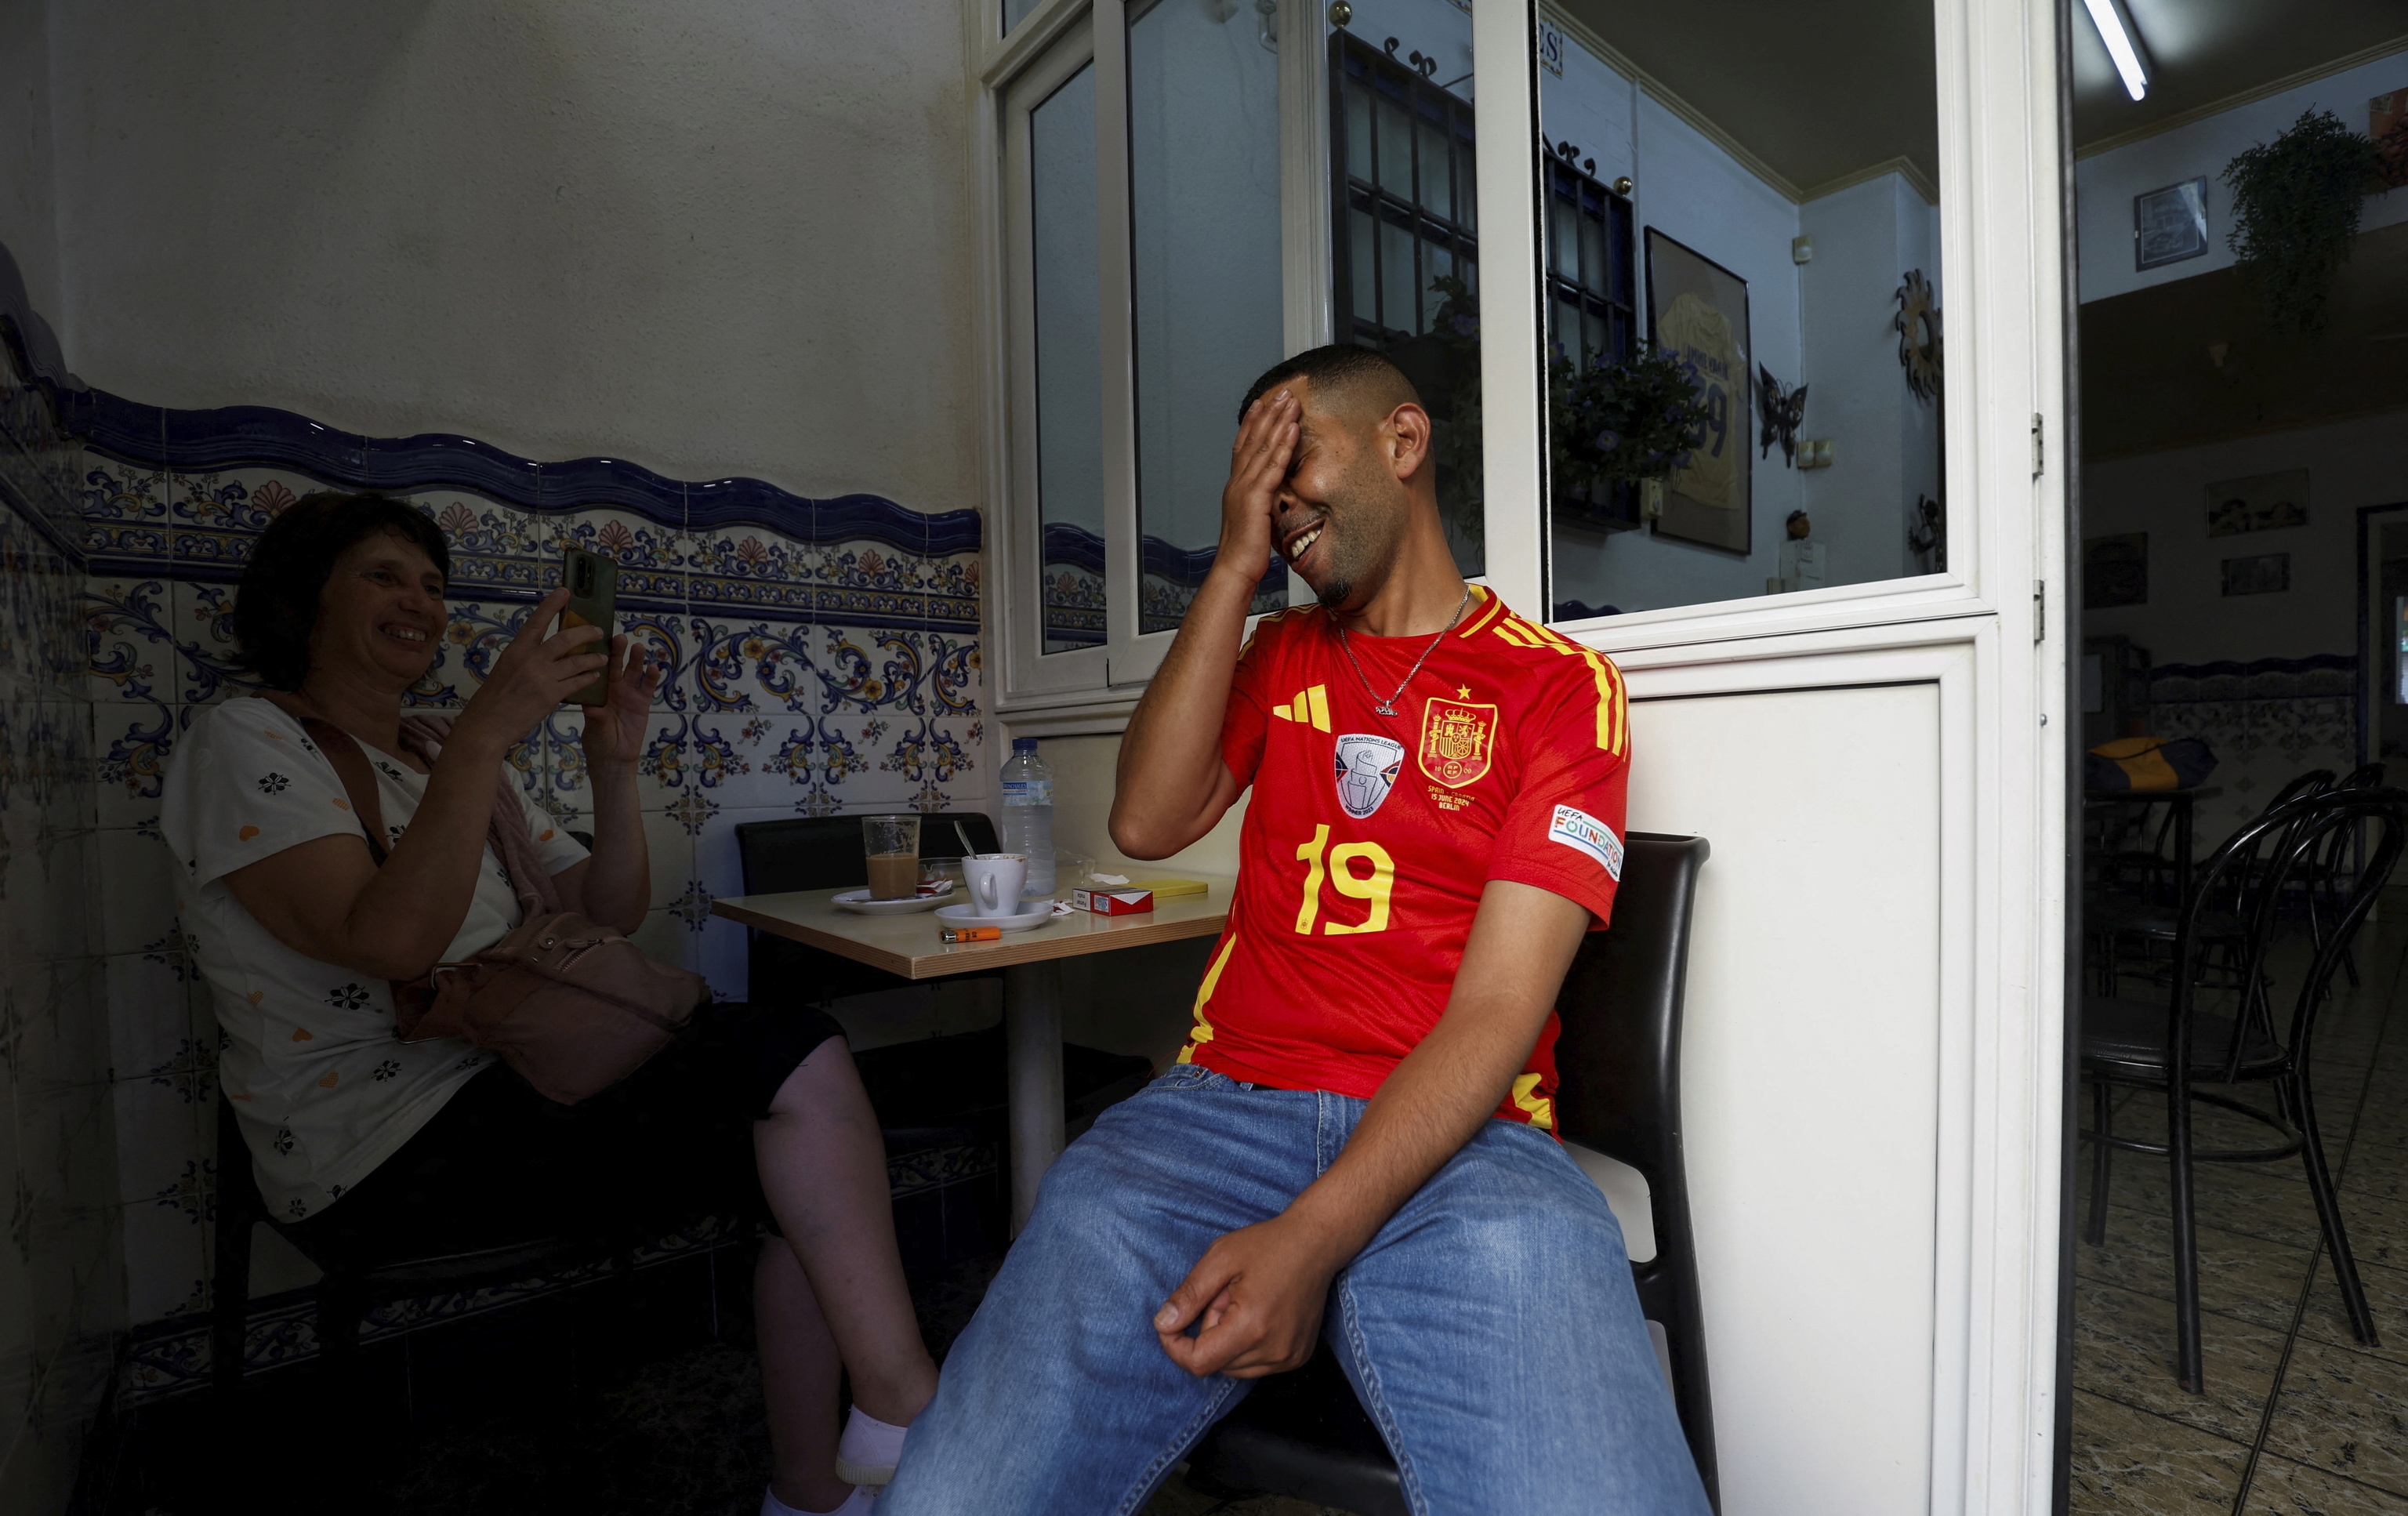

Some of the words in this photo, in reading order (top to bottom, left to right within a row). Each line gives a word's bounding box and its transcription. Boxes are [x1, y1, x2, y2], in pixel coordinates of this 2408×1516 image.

[1380, 740, 1402, 750] LEAGUE
[1427, 785, 1445, 795] SPAIN
[1438, 793, 1452, 803] JUNE
[1454, 797, 1470, 807] 2024
[1438, 801, 1460, 811] BERLIN
[1345, 803, 1362, 815] WINNER
[1557, 807, 1583, 821] UEFA
[1554, 816, 1622, 869] FOUNDATION
[1295, 823, 1395, 935] 19
